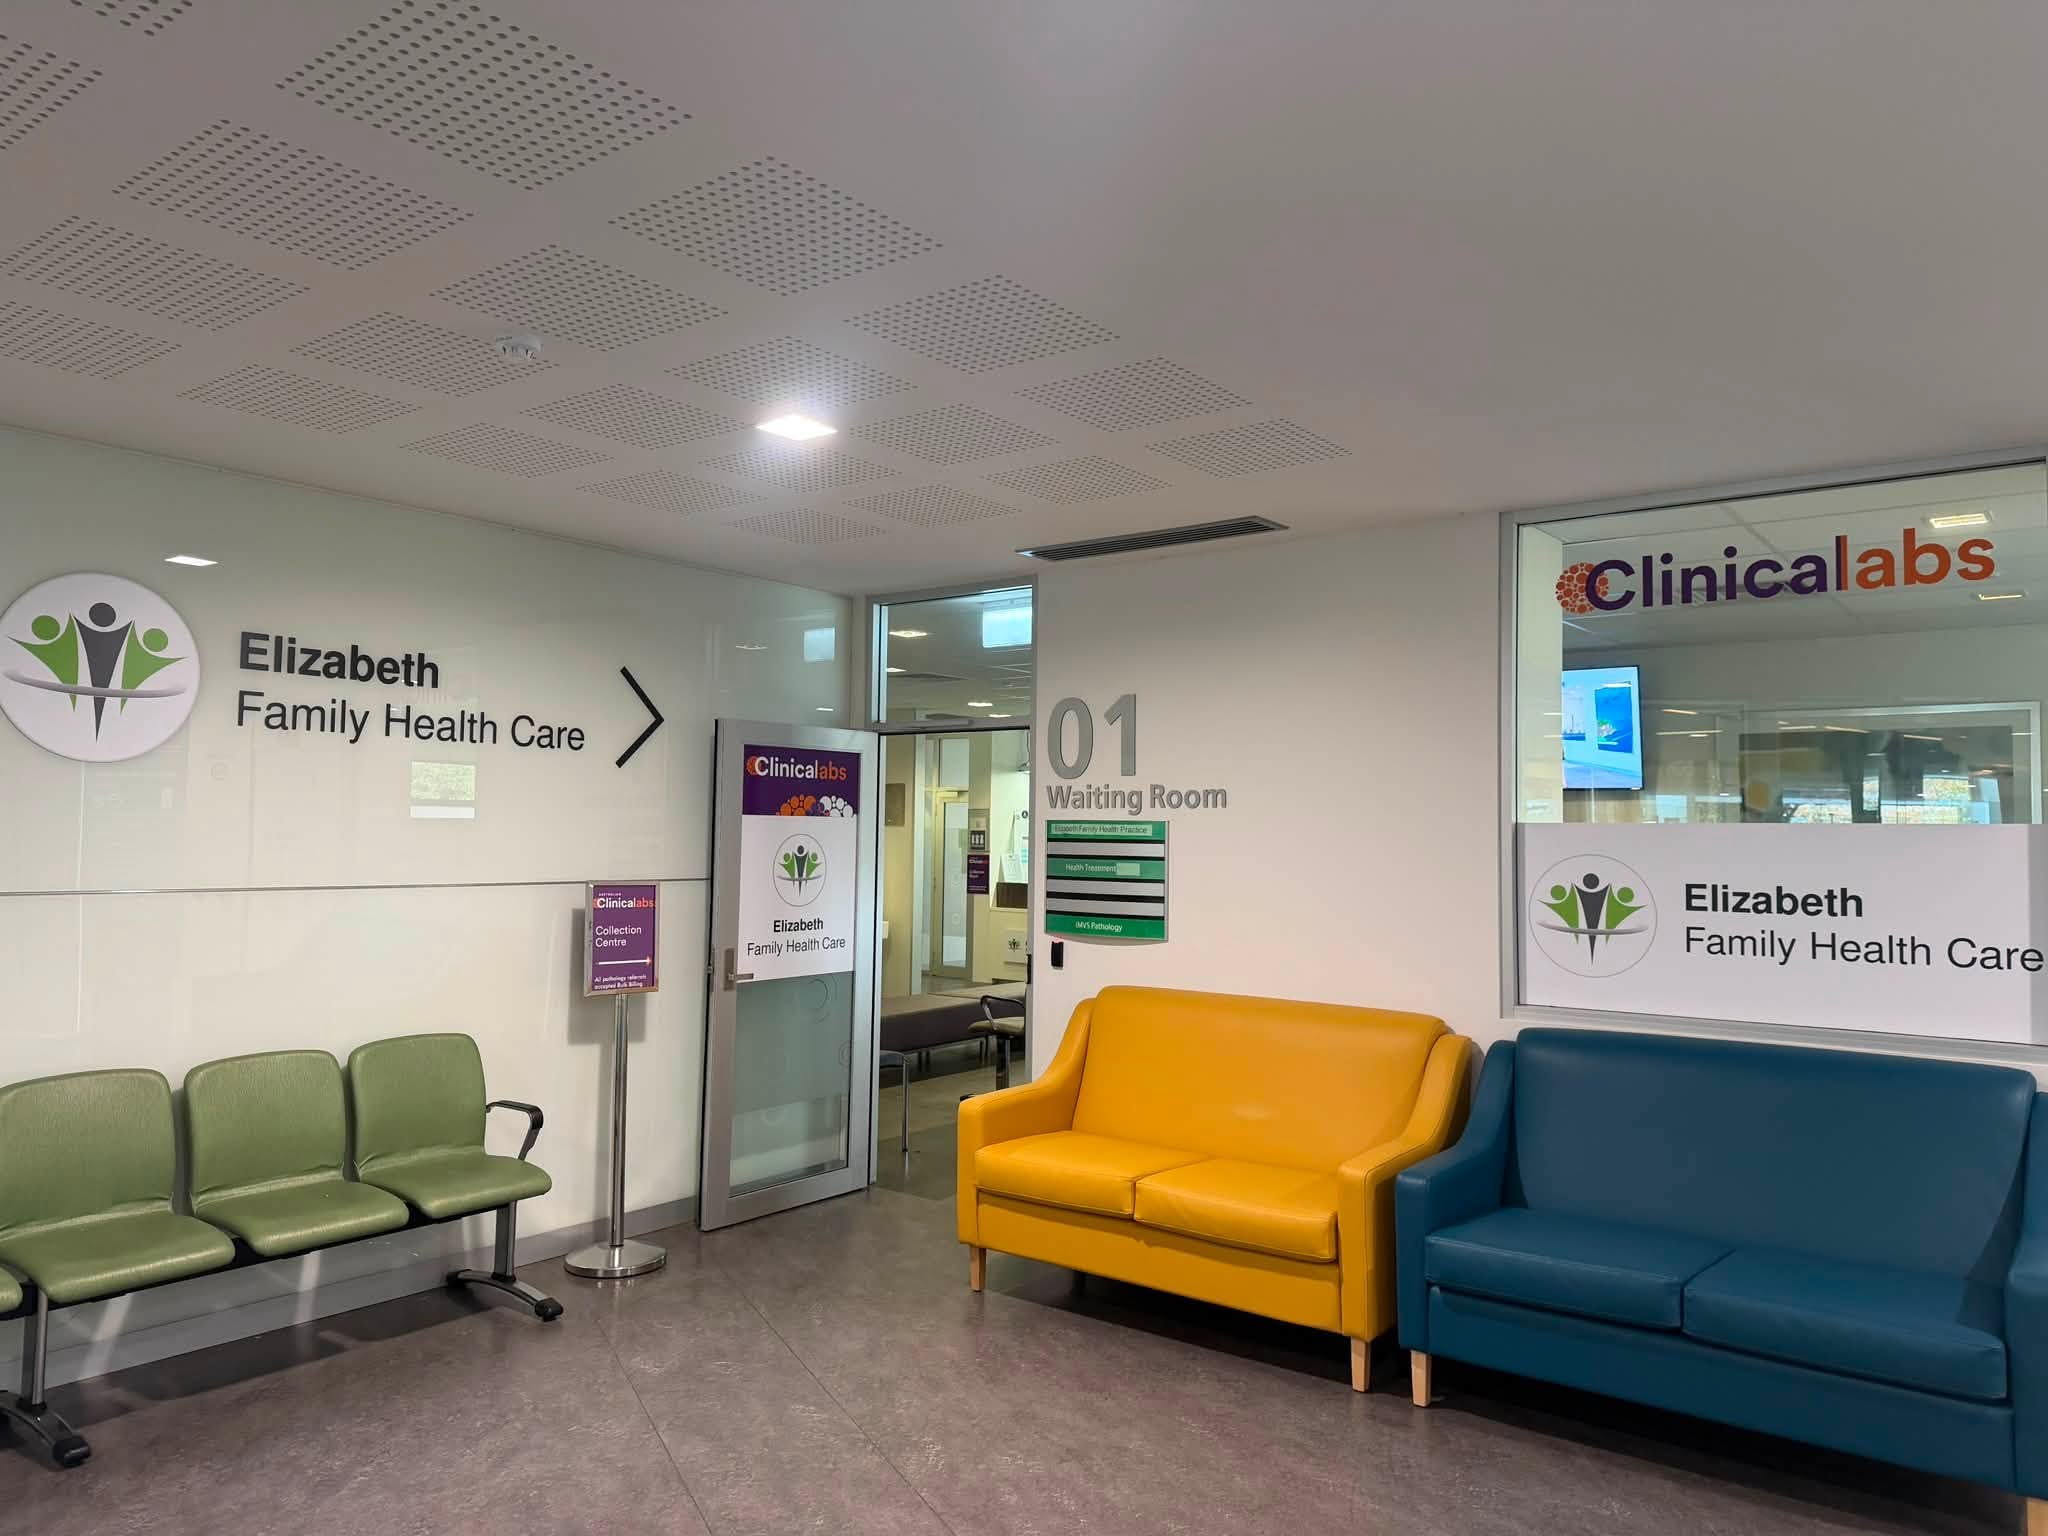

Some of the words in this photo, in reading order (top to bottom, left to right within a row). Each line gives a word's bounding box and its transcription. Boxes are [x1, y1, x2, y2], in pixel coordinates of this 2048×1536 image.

[1585, 528, 1996, 611] Clinicalabs
[239, 631, 440, 688] Elizabeth
[237, 691, 369, 744] Family
[383, 704, 499, 745] Health
[510, 715, 586, 751] Care
[1047, 693, 1137, 780] 01
[754, 756, 848, 781] Clinicalabs
[1046, 784, 1143, 816] Waiting
[1150, 784, 1228, 809] Room
[1079, 825, 1098, 834] Family
[1099, 825, 1119, 834] Health
[1120, 826, 1148, 834] Practice
[1065, 863, 1084, 873] Health
[1085, 864, 1117, 873] Treatment
[596, 897, 654, 909] Clinicalabs
[1685, 883, 1864, 917] Elizabeth
[595, 925, 642, 936] Collection
[773, 918, 824, 933] Elizabeth
[1075, 921, 1091, 929] IMVS
[1091, 922, 1122, 933] Pathology
[595, 937, 627, 948] Centre
[747, 940, 783, 957] Family
[786, 938, 820, 954] Health
[822, 935, 846, 950] Care
[1685, 926, 1796, 965] Family
[1810, 931, 1932, 965] Health
[1946, 937, 2044, 972] Care
